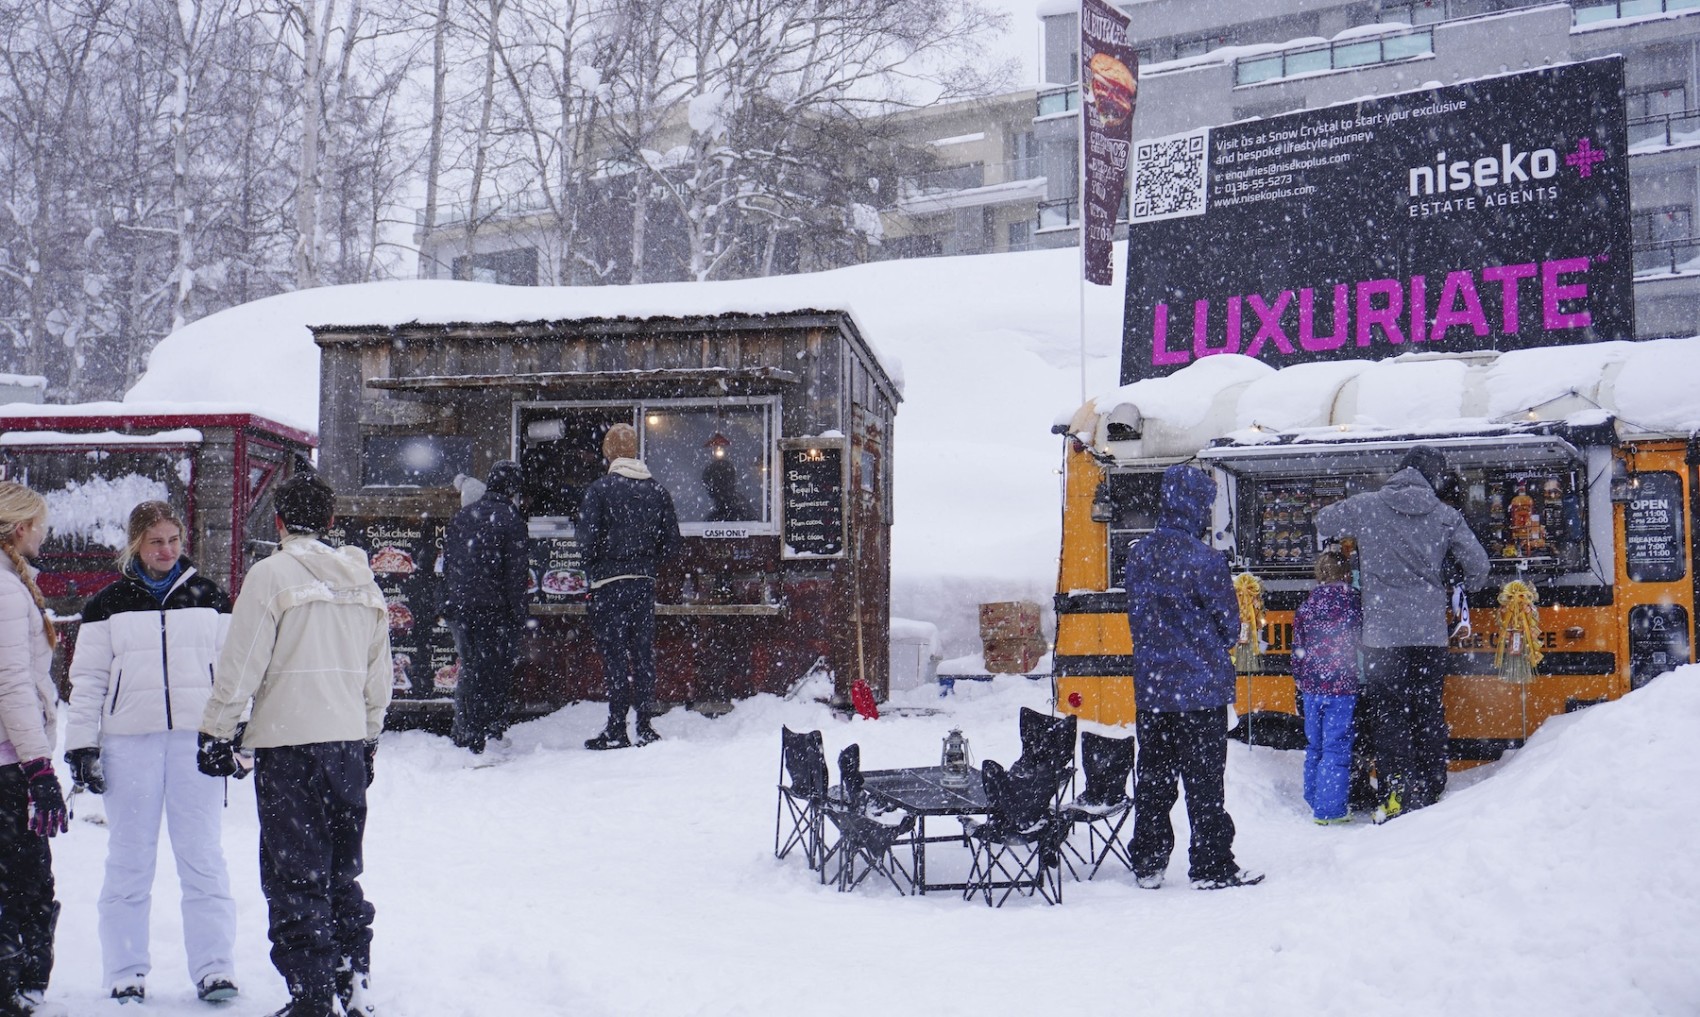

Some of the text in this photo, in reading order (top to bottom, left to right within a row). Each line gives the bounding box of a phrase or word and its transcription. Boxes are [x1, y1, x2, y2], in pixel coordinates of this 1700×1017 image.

[1216, 100, 1467, 151] Visit us at Snow Crystal to start your exclusive
[1215, 152, 1235, 165] and
[1237, 146, 1281, 161] bespoke
[1284, 137, 1328, 153] lifestyle
[1225, 153, 1351, 179] enquiries@nisekoplus.com
[1409, 143, 1557, 197] niseko
[1214, 175, 1292, 195] t: 0136-55-5273
[1214, 185, 1316, 207] www.nisekoplus.com
[1410, 186, 1557, 217] ESTATE AGENTS
[1152, 256, 1592, 366] LUXURIATE
[789, 470, 811, 481] Beer
[791, 483, 819, 497] Tequila
[1630, 500, 1668, 510] OPEN
[1646, 516, 1668, 524] 22:00
[704, 529, 747, 537] CASH ONLY
[791, 532, 805, 542] Hot
[551, 538, 577, 547] Tacos
[1648, 549, 1670, 557] 11:00
[549, 560, 581, 568] Chicken
[383, 584, 402, 594] amb
